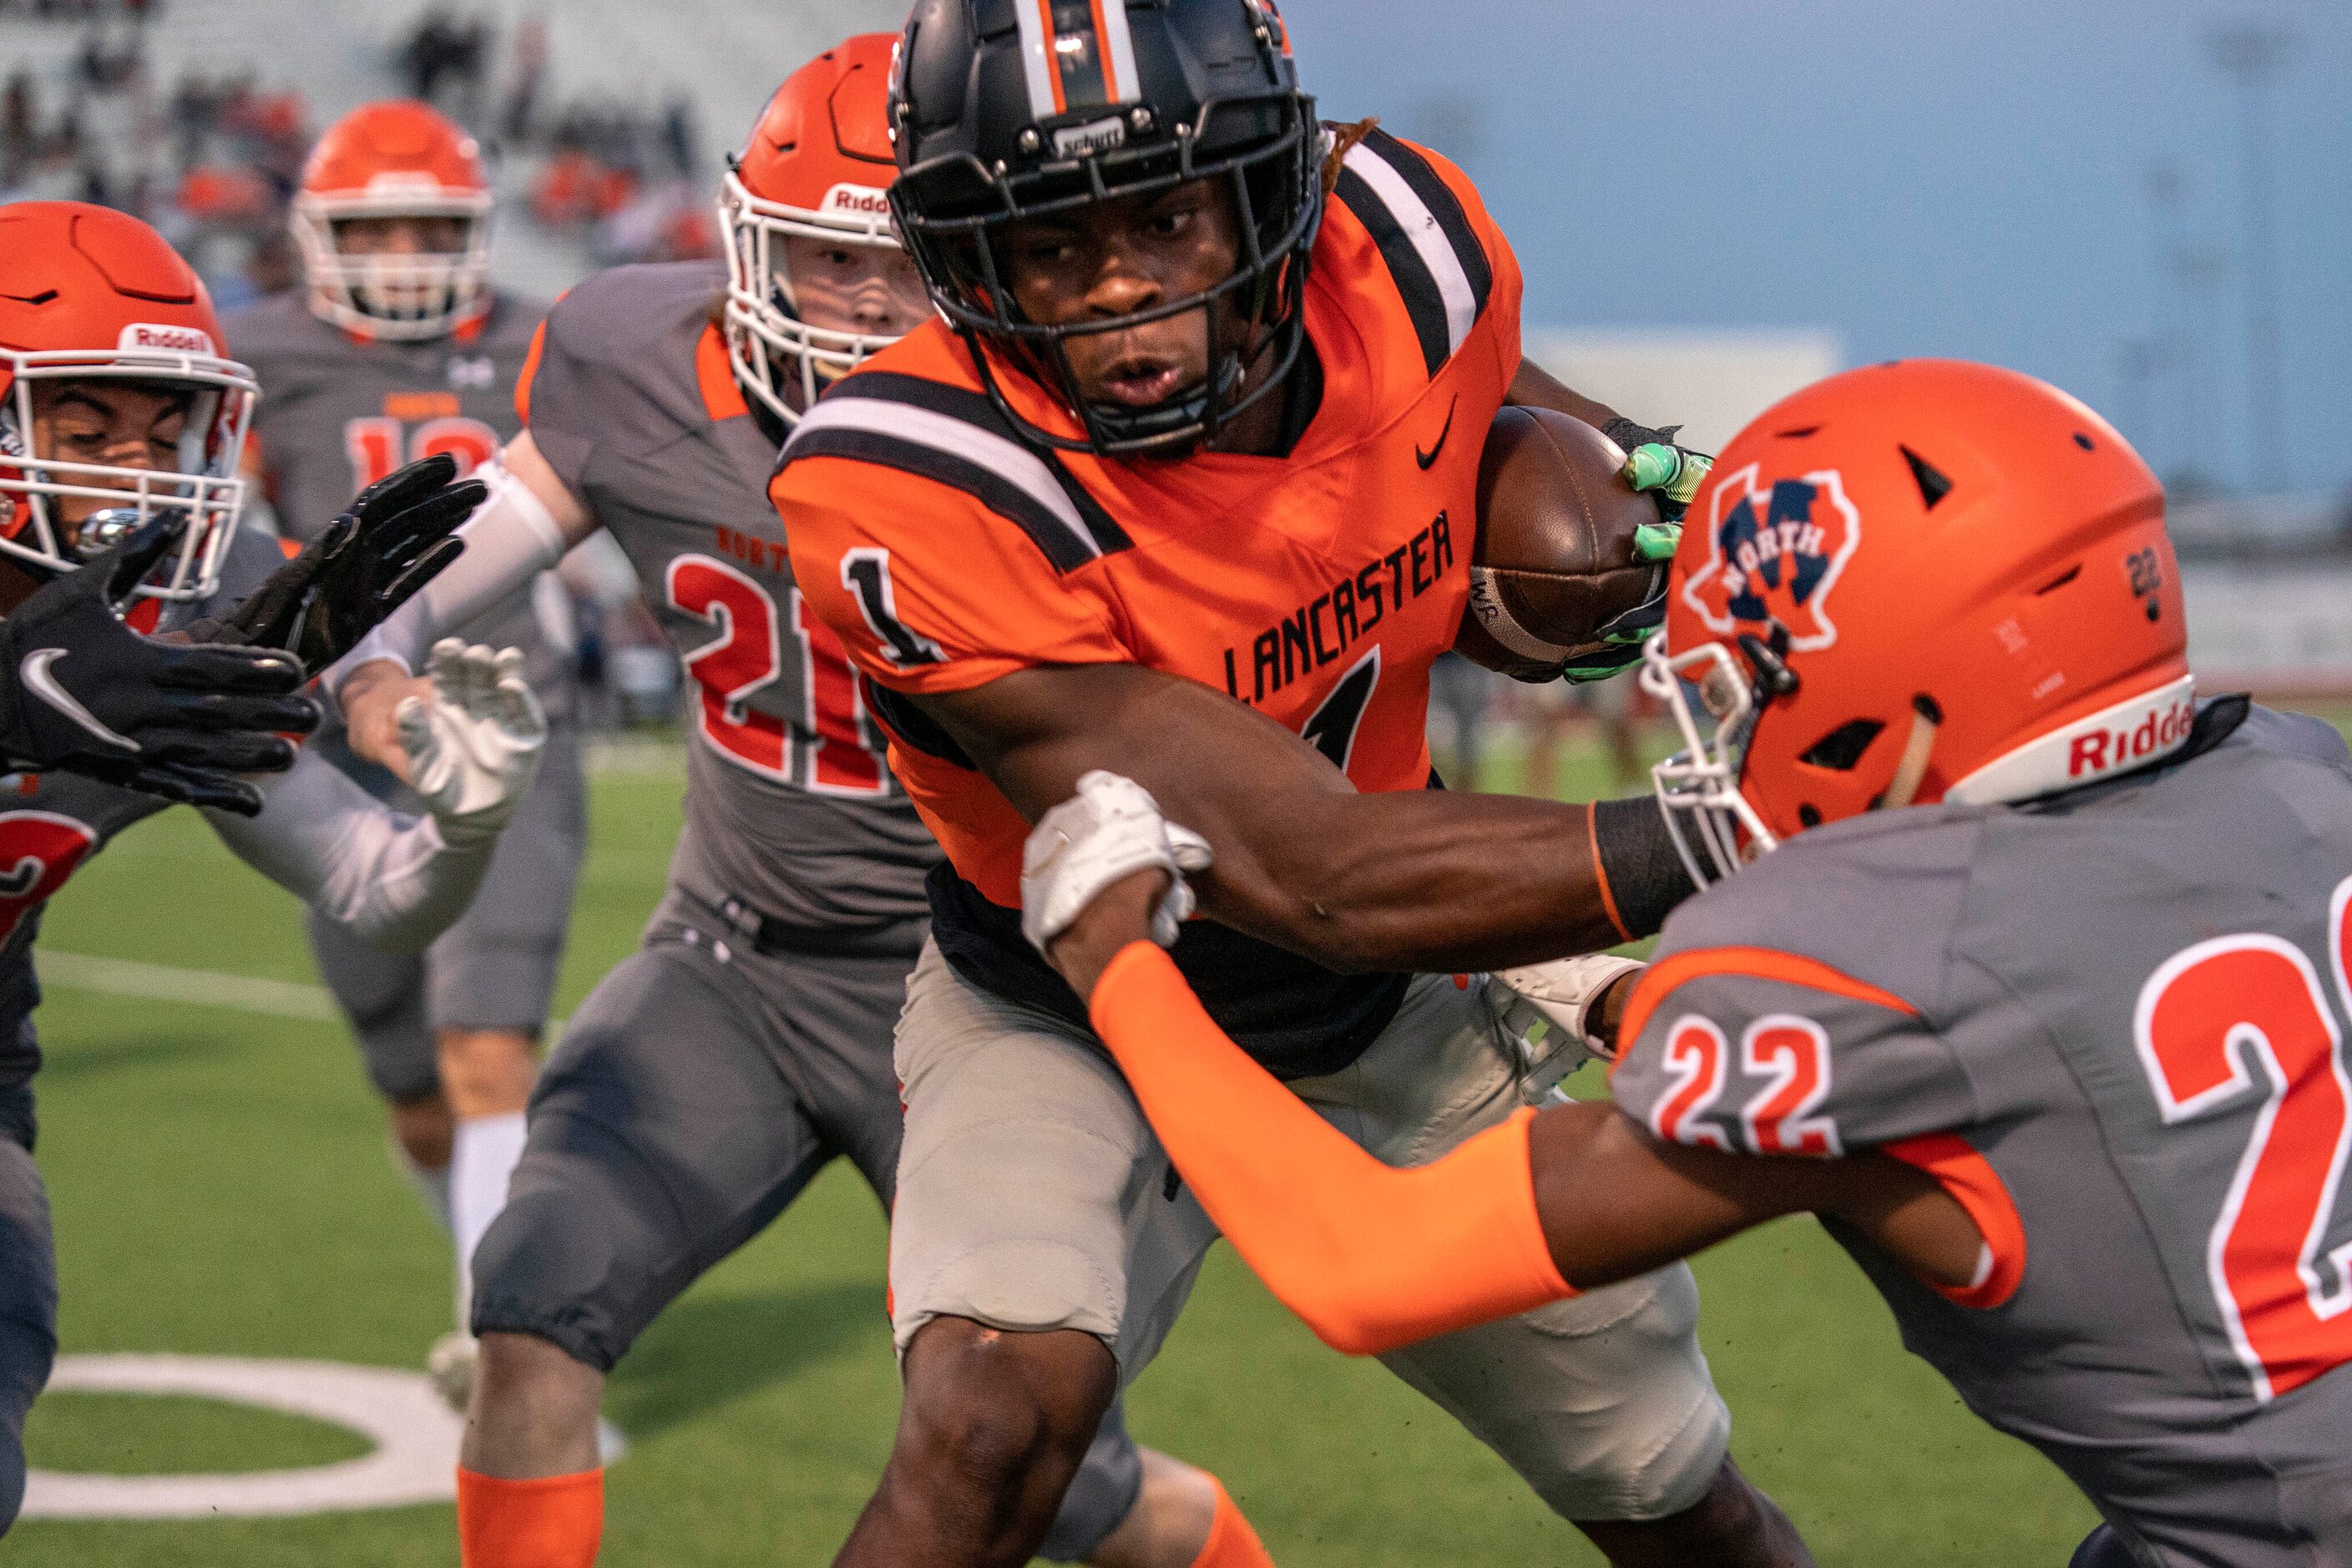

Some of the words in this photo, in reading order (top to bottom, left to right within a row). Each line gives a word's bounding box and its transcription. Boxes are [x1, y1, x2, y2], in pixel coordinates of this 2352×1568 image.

[840, 547, 952, 670] 1
[1223, 508, 1454, 705] LANCASTER
[1722, 521, 1825, 596] NORTH
[666, 553, 889, 796] 21
[1651, 1013, 1844, 1158] 22
